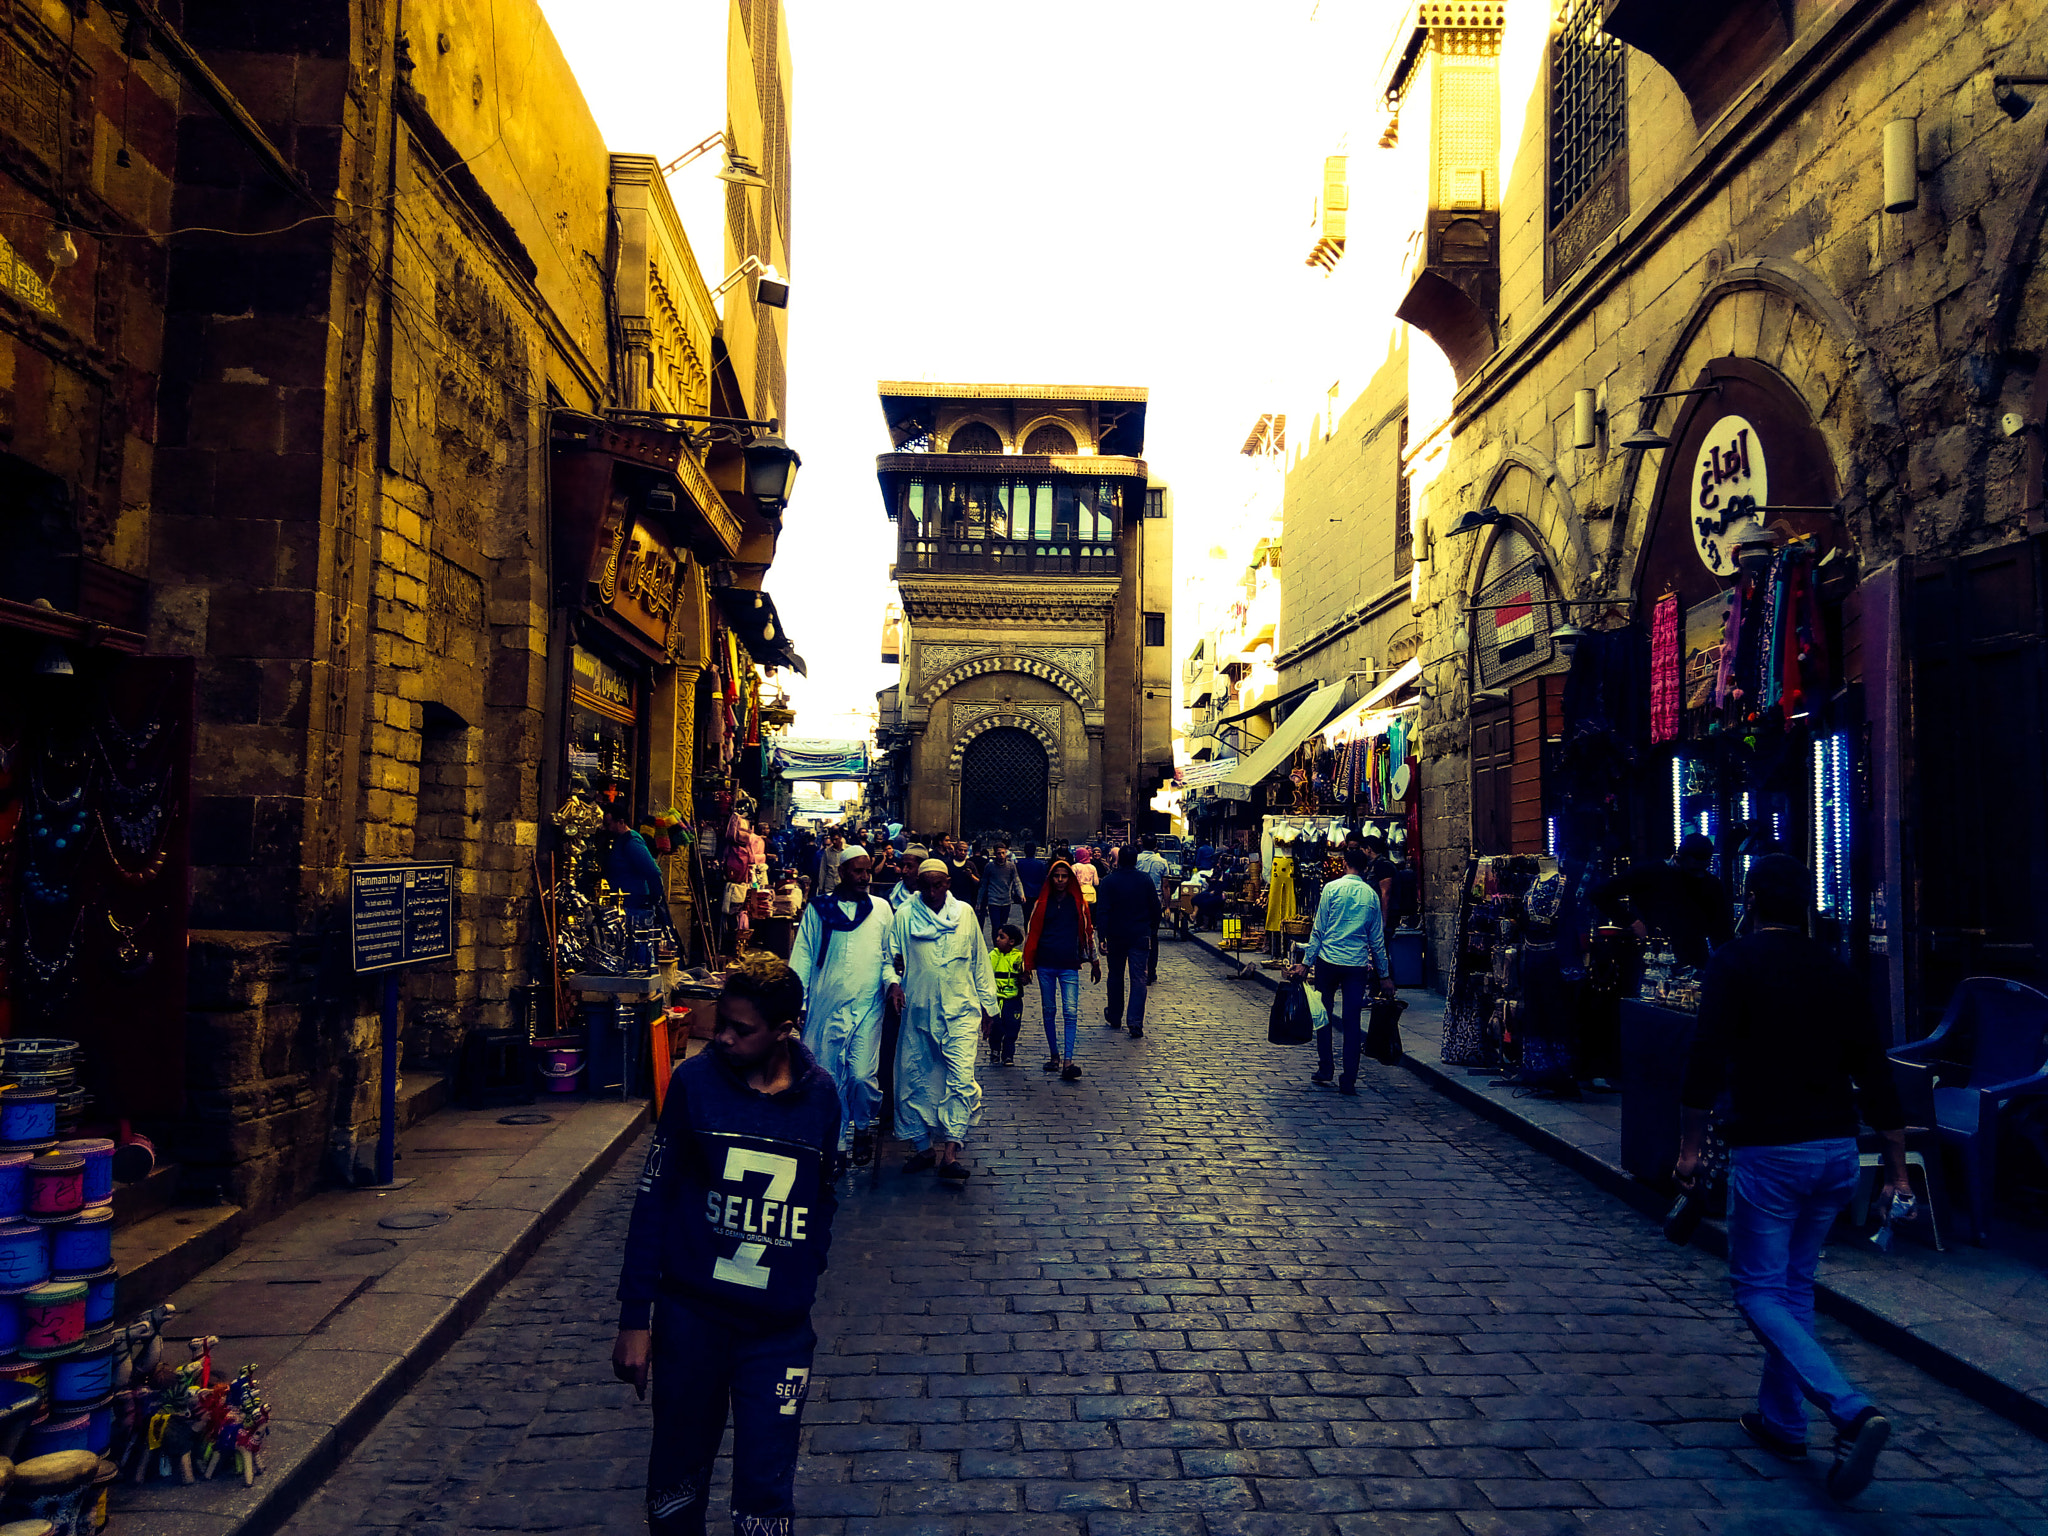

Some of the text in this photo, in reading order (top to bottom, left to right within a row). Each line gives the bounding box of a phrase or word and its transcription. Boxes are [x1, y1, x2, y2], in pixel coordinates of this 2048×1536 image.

[356, 875, 388, 886] Hammam
[389, 872, 402, 884] Inal
[705, 1190, 808, 1240] SELFIE
[746, 1233, 773, 1245] ORIGINAL
[774, 1239, 793, 1247] DESIN
